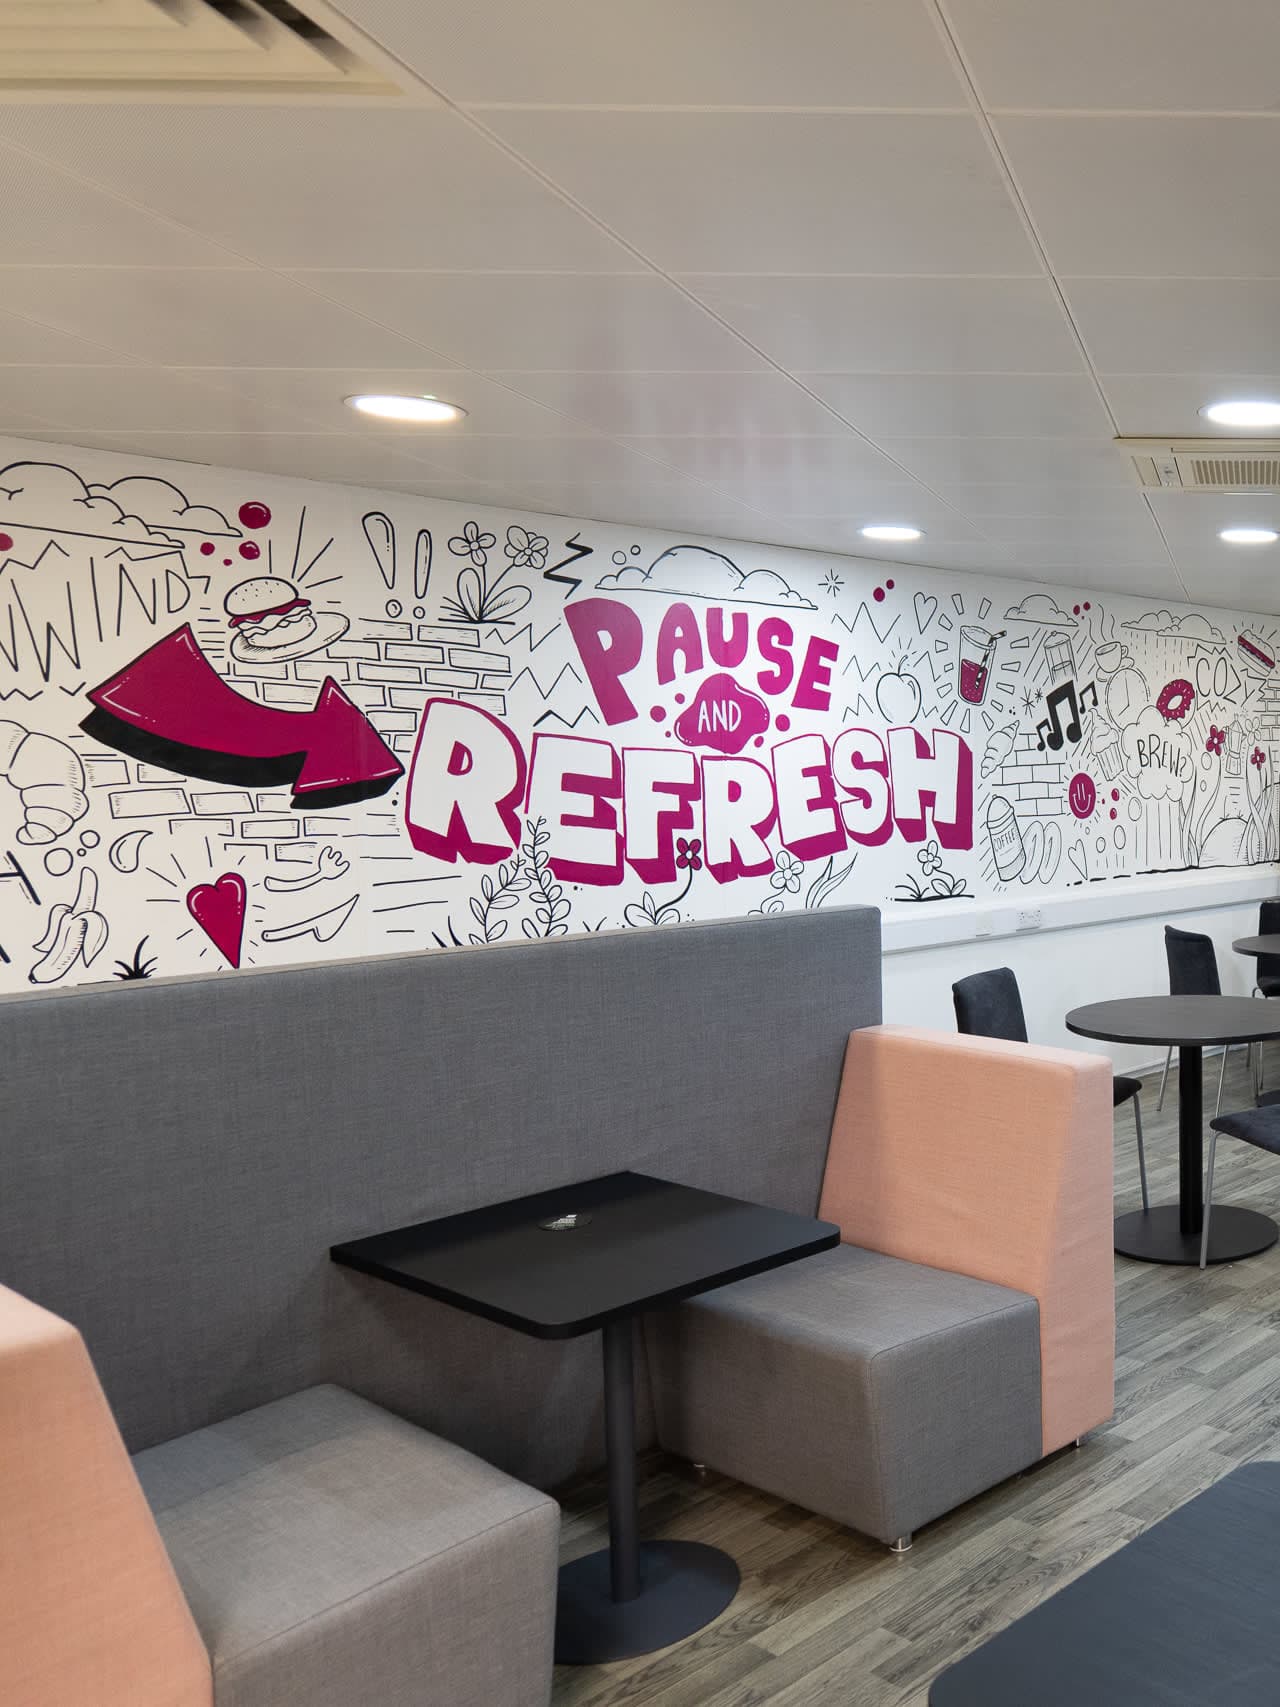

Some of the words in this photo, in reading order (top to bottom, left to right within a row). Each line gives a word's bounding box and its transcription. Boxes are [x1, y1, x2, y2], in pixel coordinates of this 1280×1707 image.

[564, 597, 840, 726] PAUSE
[1195, 656, 1256, 707] COZY
[697, 702, 742, 733] AND
[1137, 733, 1187, 777] BREW?
[404, 696, 975, 886] REFRESH
[993, 827, 1015, 852] COFFEE
